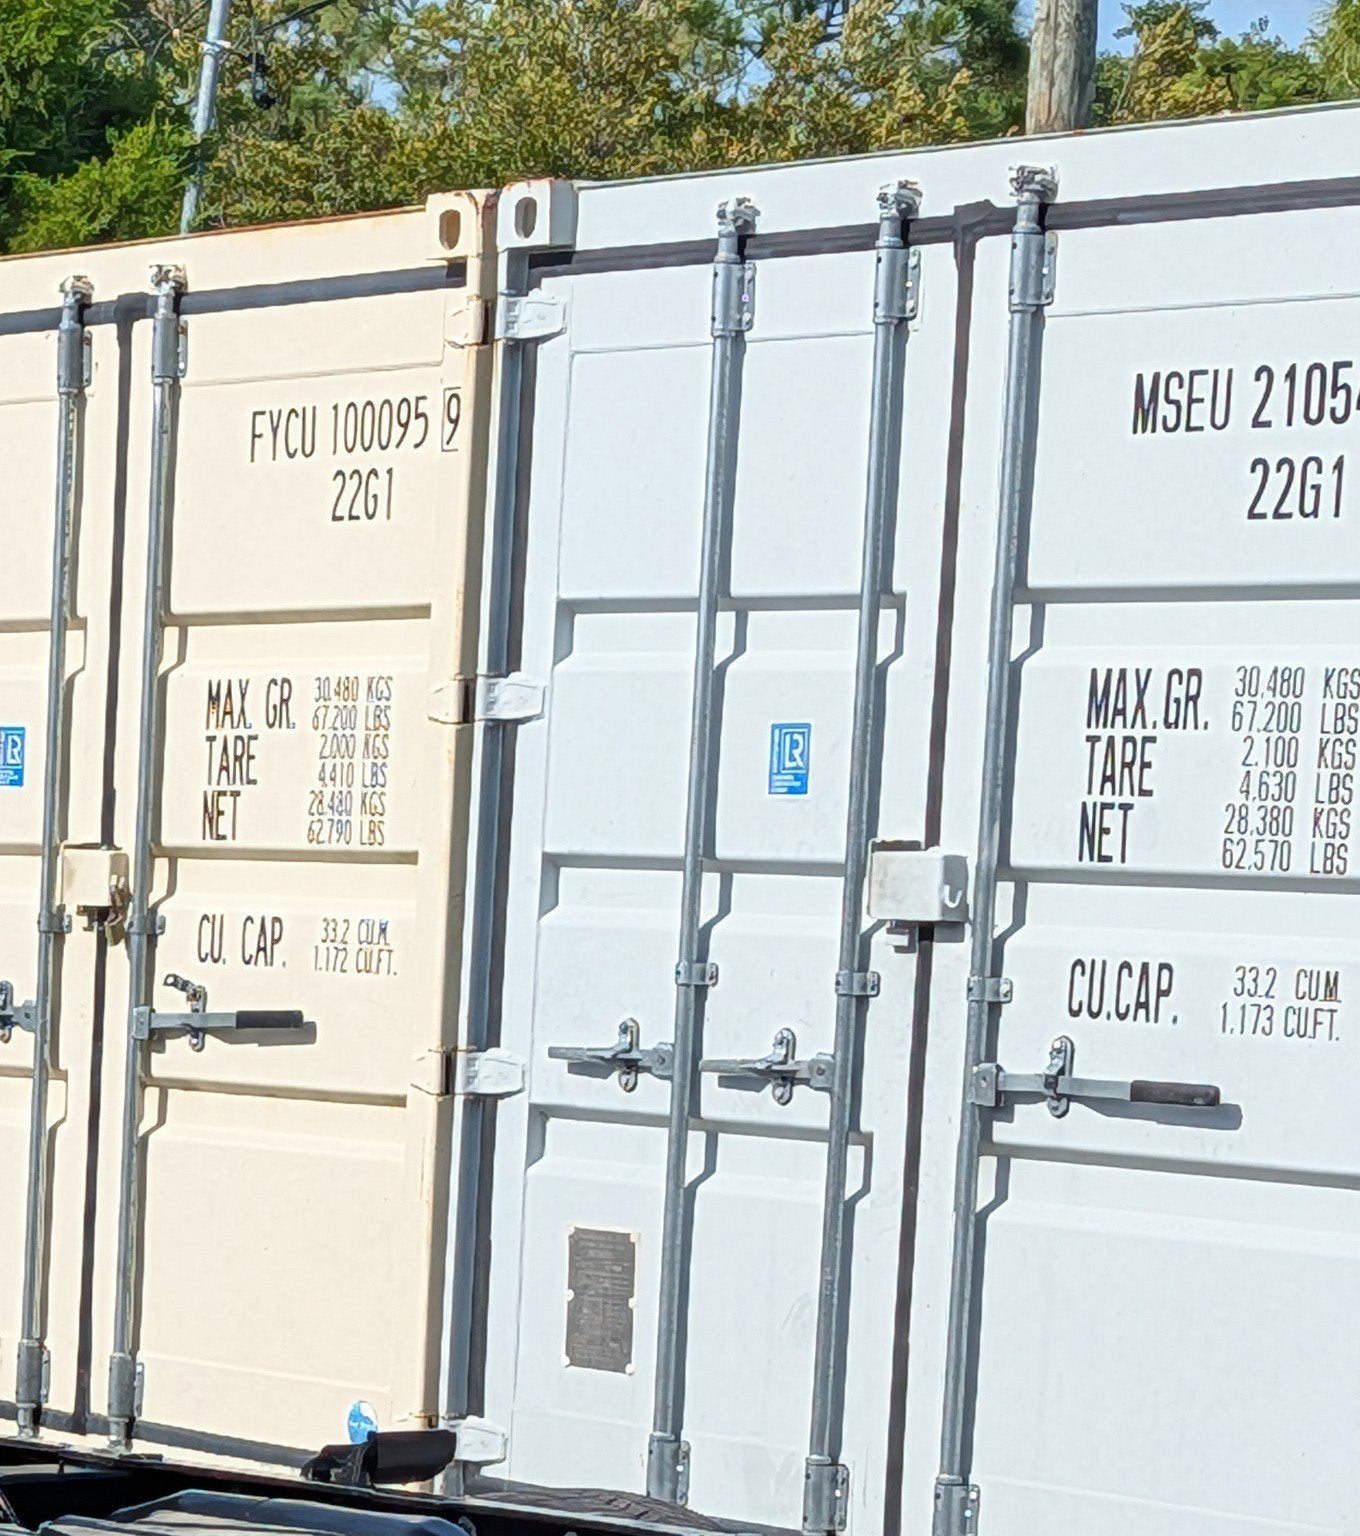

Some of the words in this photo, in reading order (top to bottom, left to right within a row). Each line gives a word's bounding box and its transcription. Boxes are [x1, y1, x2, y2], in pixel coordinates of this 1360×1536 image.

[1132, 367, 1234, 434] MSEU
[1251, 360, 1360, 428] 2105
[250, 405, 316, 463] FYCU
[332, 395, 429, 455] 100095
[446, 393, 462, 446] 9
[332, 467, 393, 521] 22G1
[1247, 454, 1345, 520] 22G1
[366, 675, 394, 702] KGS
[1322, 666, 1360, 700] KGS
[364, 705, 391, 732] LBS
[1320, 702, 1360, 735] LBS
[205, 734, 259, 786] TARE
[362, 733, 389, 760] KGS
[362, 762, 388, 789] LBS
[1085, 735, 1157, 797] TARE
[1317, 737, 1357, 770] KGS
[1314, 772, 1354, 806] LBS
[202, 790, 241, 841] NET
[360, 791, 387, 817] KGS
[359, 819, 385, 846] LBS
[1078, 801, 1134, 864] NET
[1312, 807, 1351, 840] KGS
[1310, 841, 1348, 876] LBS
